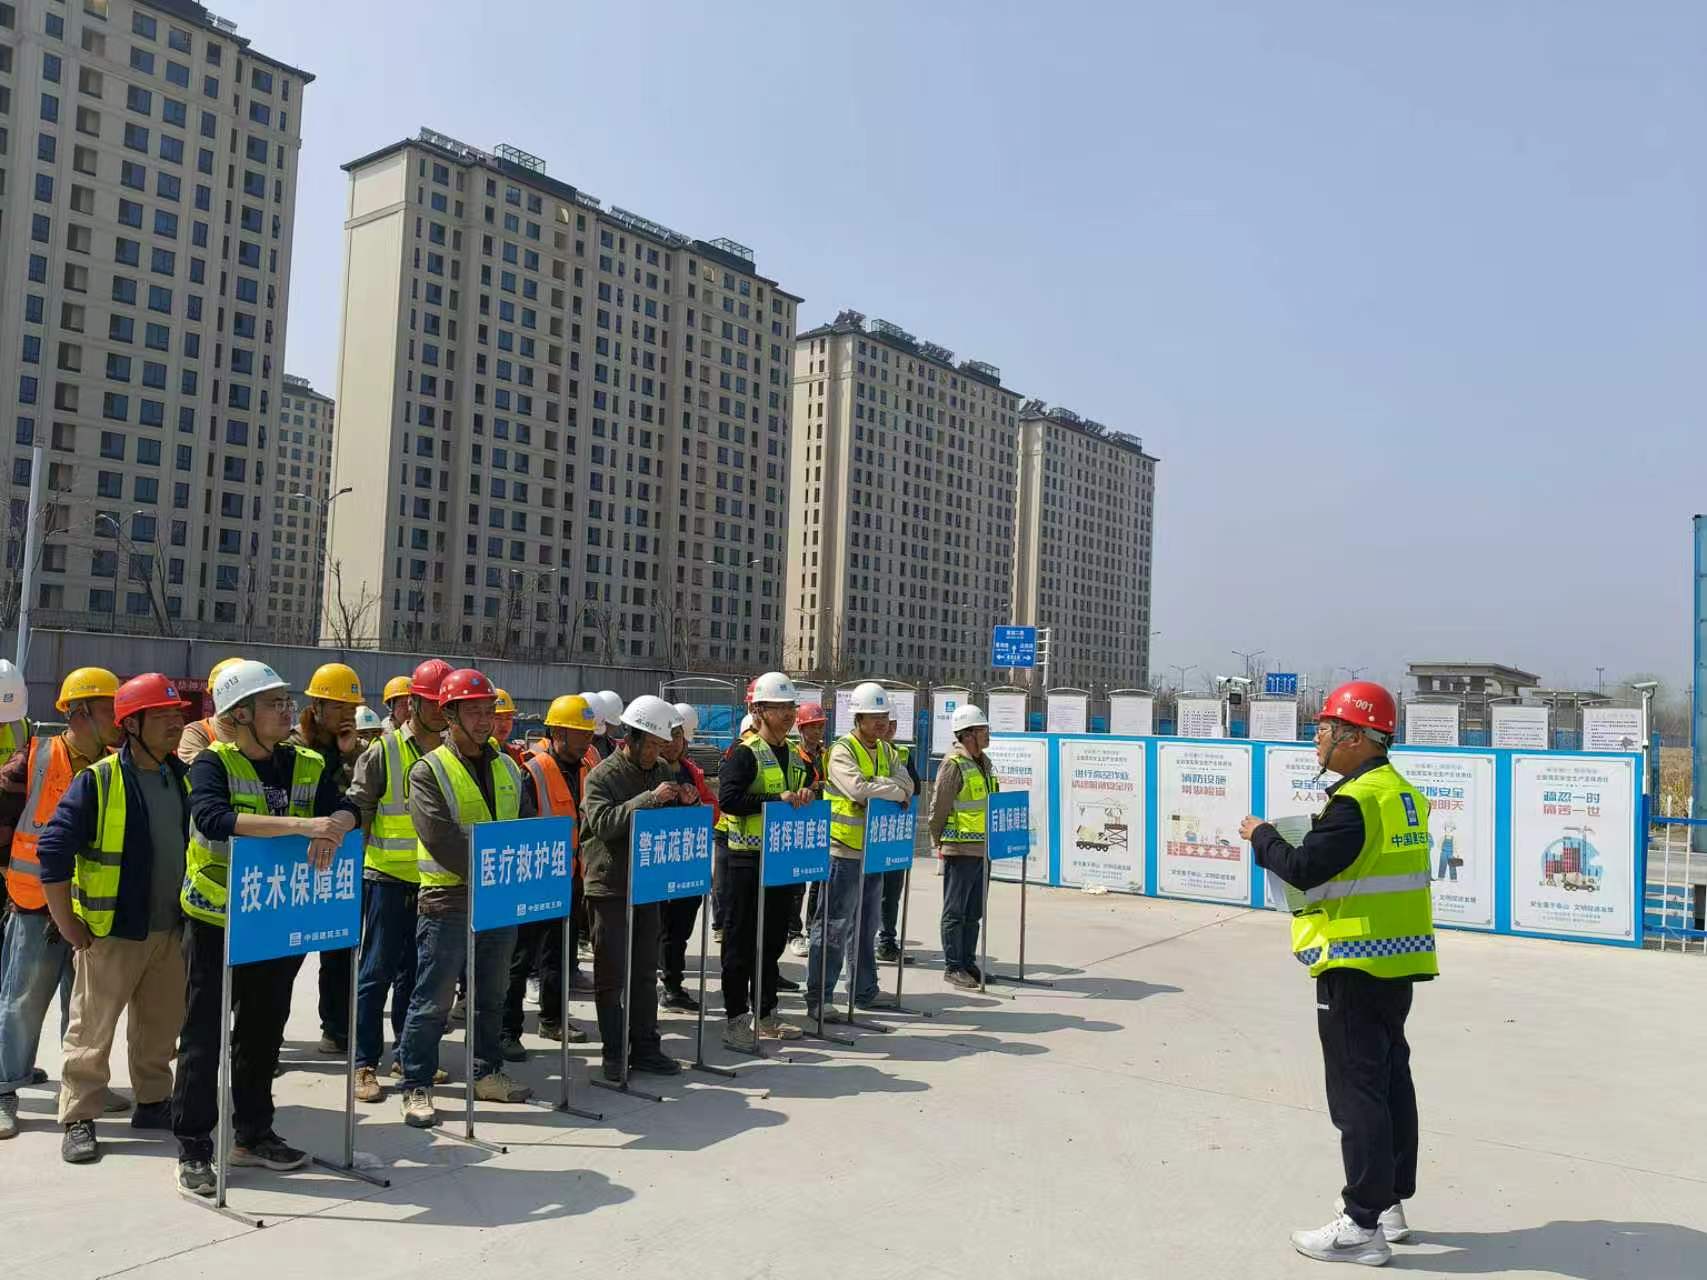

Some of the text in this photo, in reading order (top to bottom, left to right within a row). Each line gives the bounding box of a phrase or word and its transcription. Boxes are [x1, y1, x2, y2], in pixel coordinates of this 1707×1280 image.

[1182, 772, 1227, 785] 消防设施
[1543, 791, 1600, 803] 疏忽一时
[1543, 804, 1600, 817] 痛苦一世
[639, 825, 708, 867] 警戒疏散组
[769, 818, 828, 853] 指挥调度组
[481, 840, 567, 886] 医疗救护组
[241, 858, 355, 912] 技术保障组
